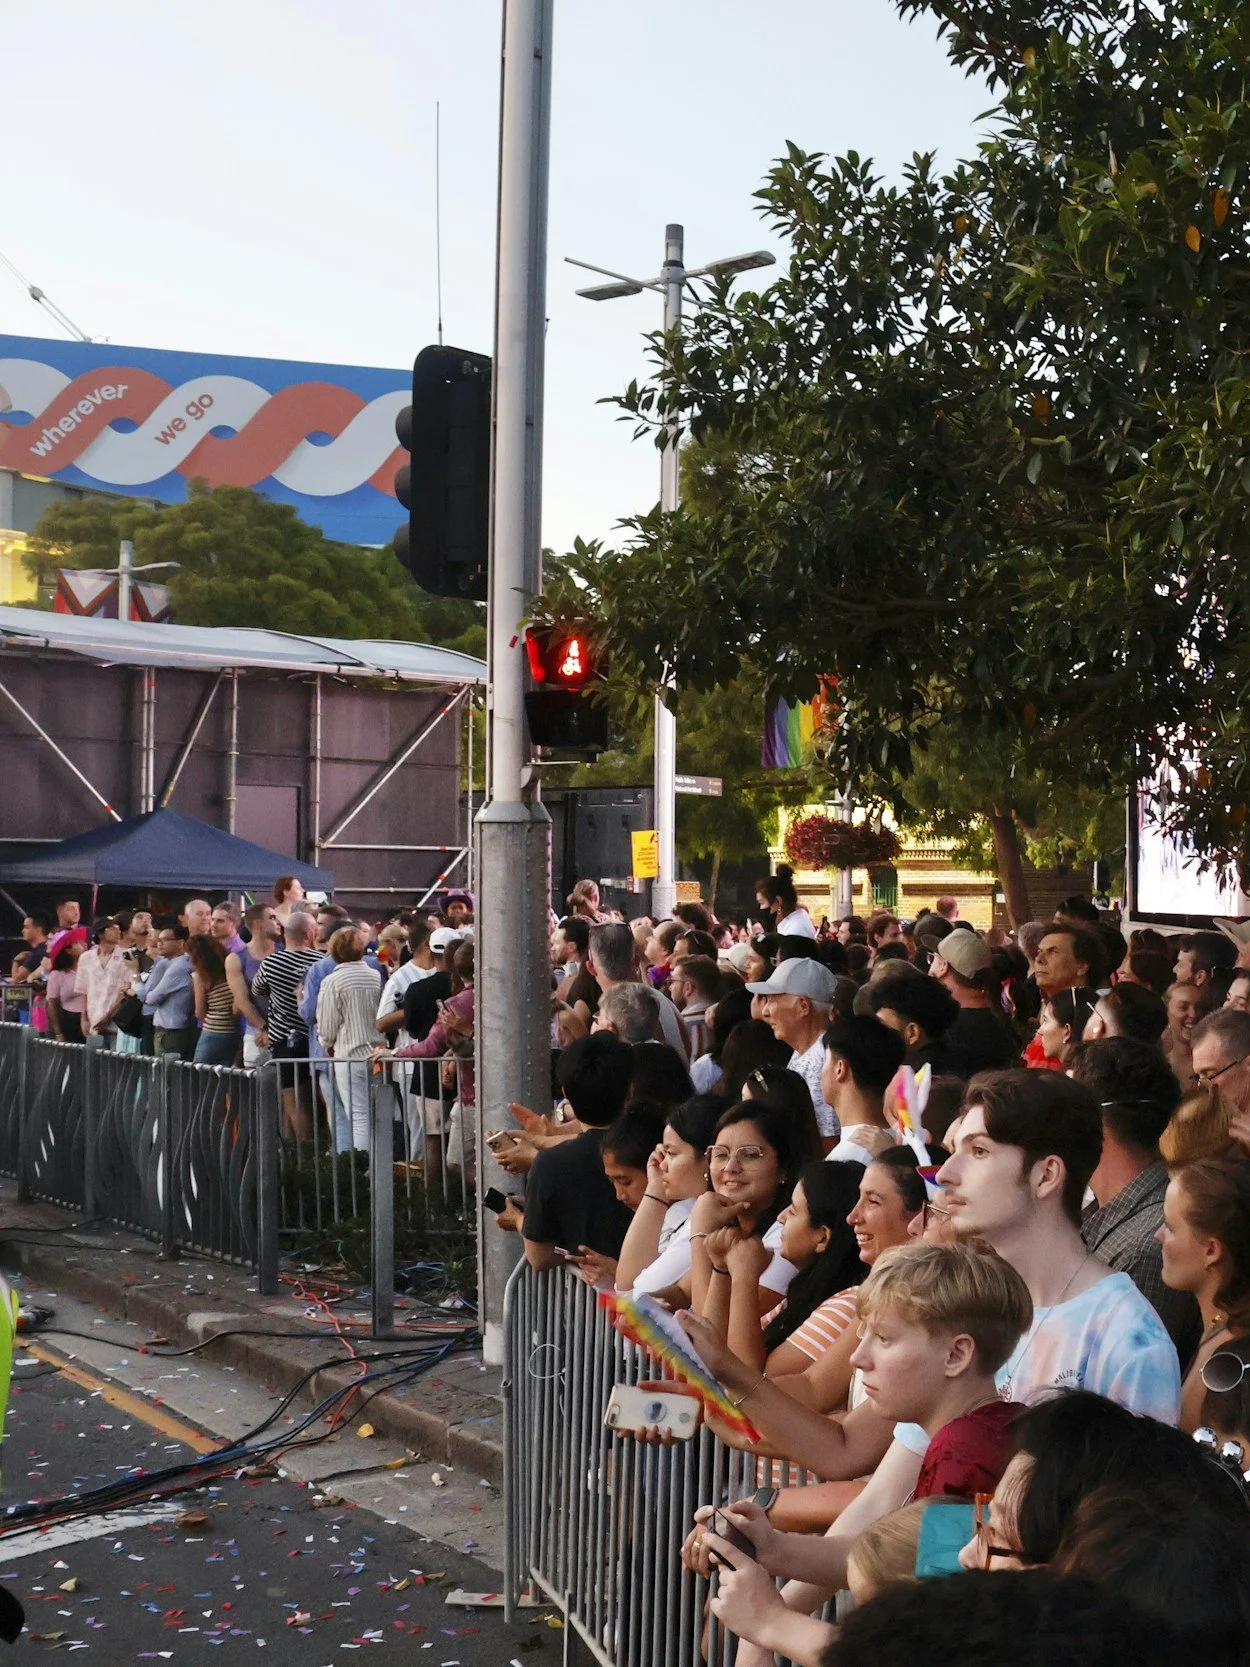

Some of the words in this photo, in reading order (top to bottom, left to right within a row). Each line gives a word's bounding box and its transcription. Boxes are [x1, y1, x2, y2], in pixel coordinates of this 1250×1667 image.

[29, 384, 129, 457] wherever
[154, 417, 187, 446] we
[185, 393, 214, 420] go
